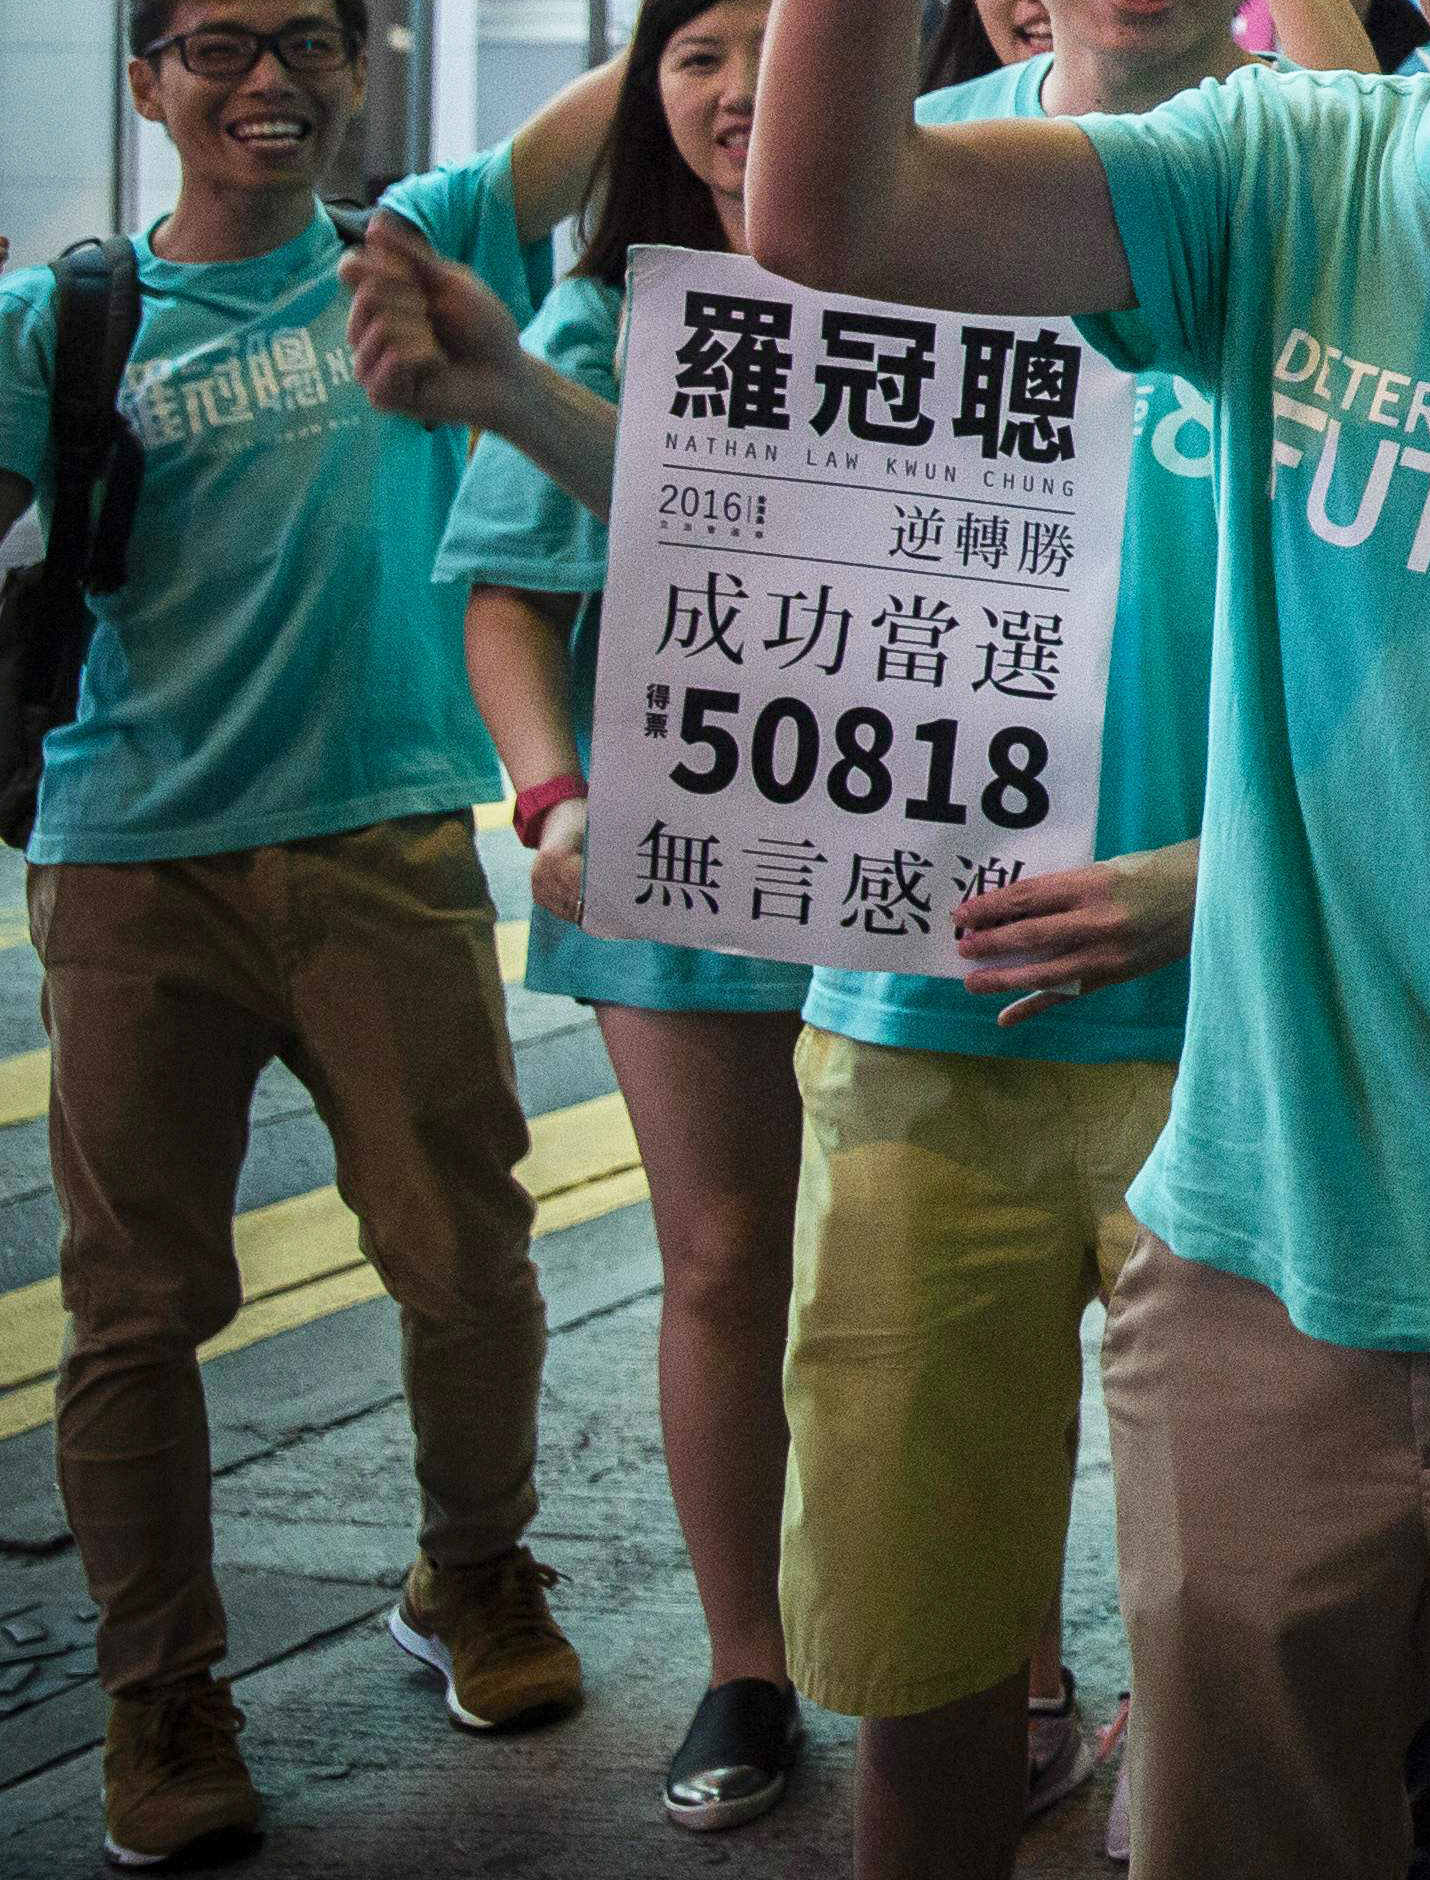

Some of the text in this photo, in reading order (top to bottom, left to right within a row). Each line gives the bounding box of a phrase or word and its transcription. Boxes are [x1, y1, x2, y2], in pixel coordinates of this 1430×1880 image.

[668, 291, 1081, 465] 羅冠聰
[658, 483, 742, 522] 2016
[665, 432, 1075, 498] NATHAN LAW KWUN CHUNG
[889, 504, 1075, 579] 逆轉勝
[655, 571, 1065, 702] 成功當選
[644, 682, 669, 739] 得票
[669, 687, 1050, 830] 50818
